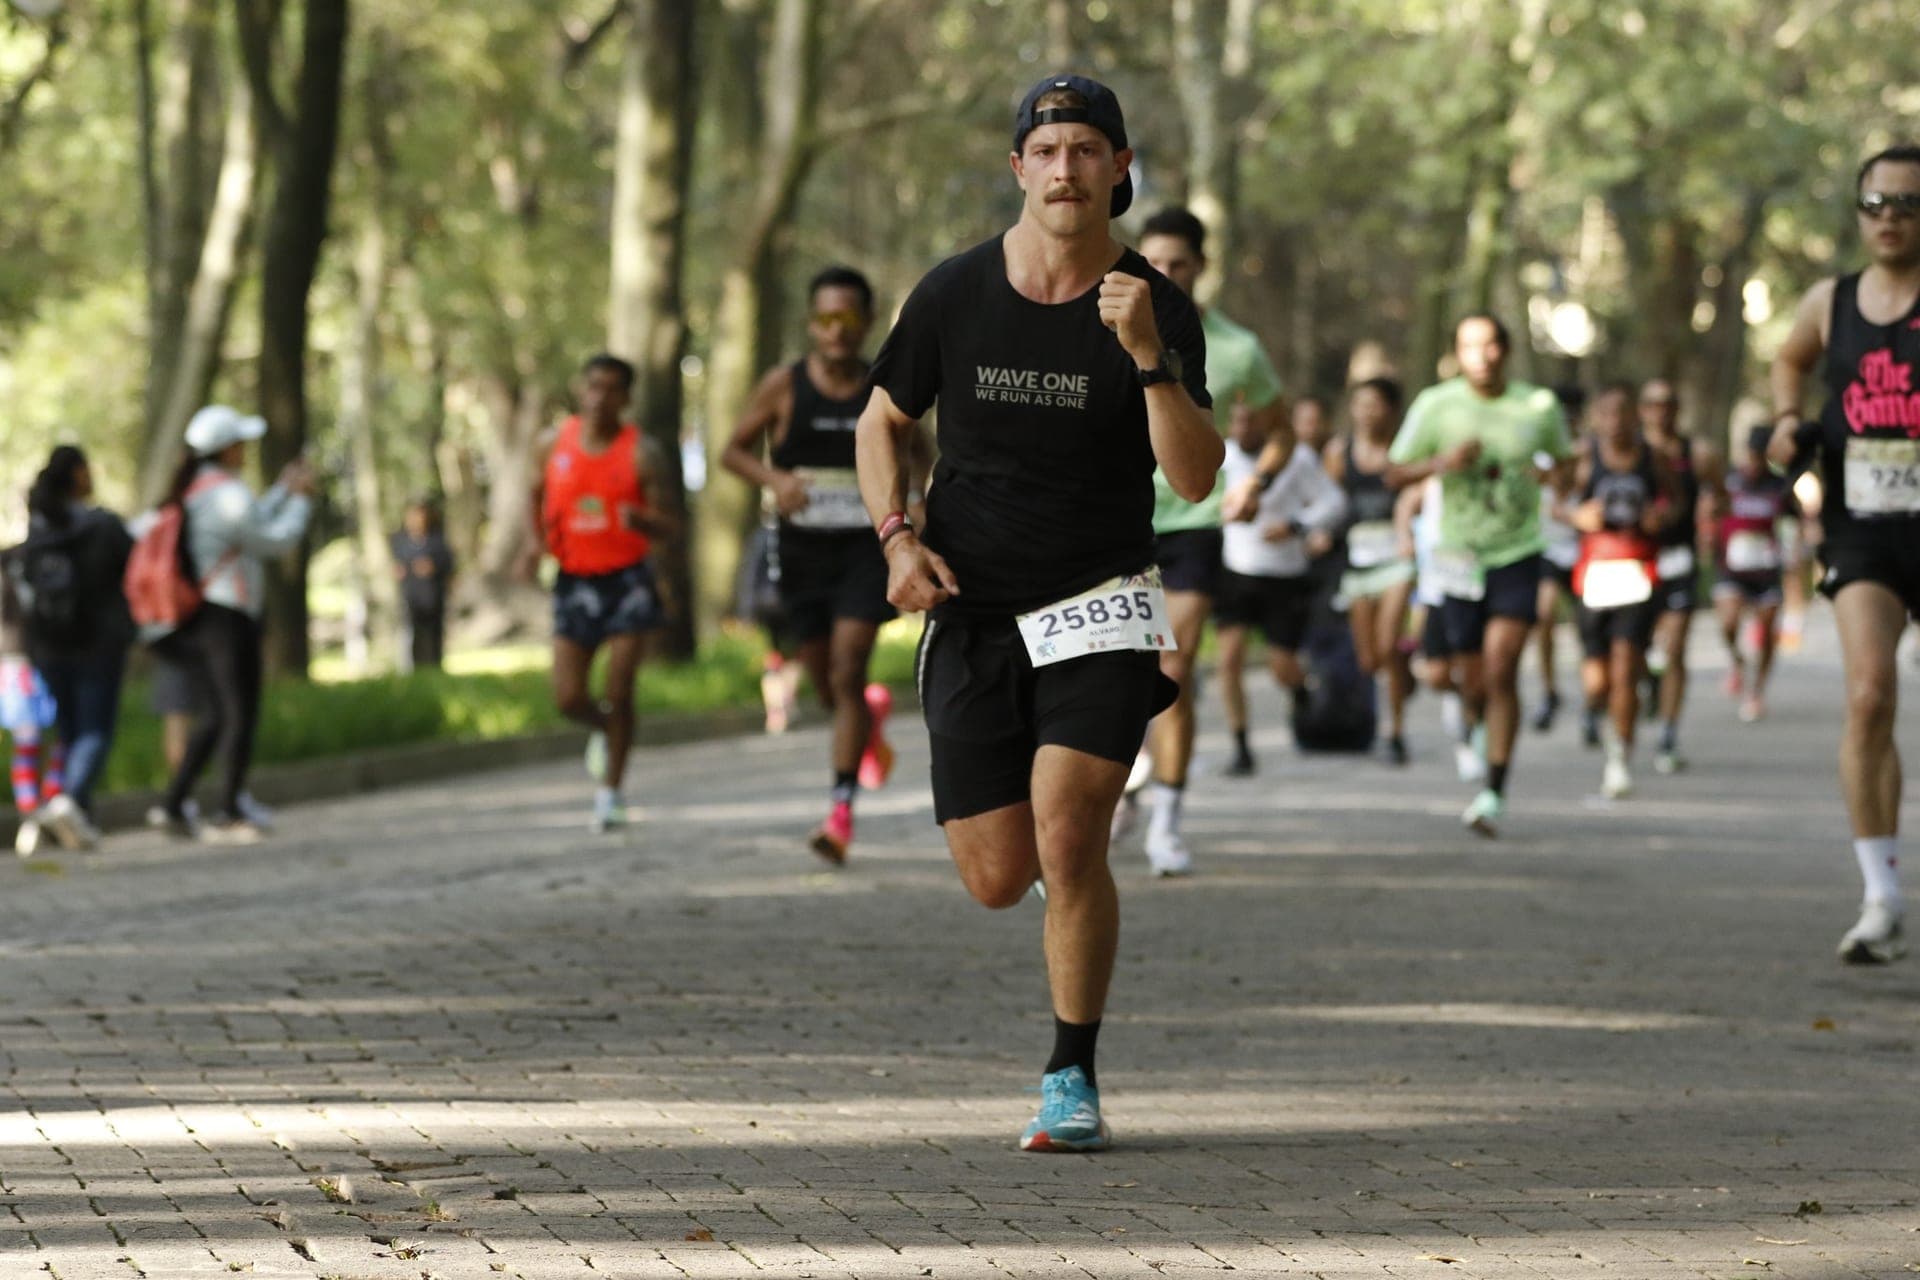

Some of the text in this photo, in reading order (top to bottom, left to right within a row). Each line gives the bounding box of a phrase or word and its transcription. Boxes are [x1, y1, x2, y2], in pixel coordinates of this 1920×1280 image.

[976, 365, 1090, 393] WAVE ONE
[1859, 348, 1912, 394] The
[976, 388, 1085, 409] WE RUN AS ONE
[1039, 592, 1153, 638] 25835
